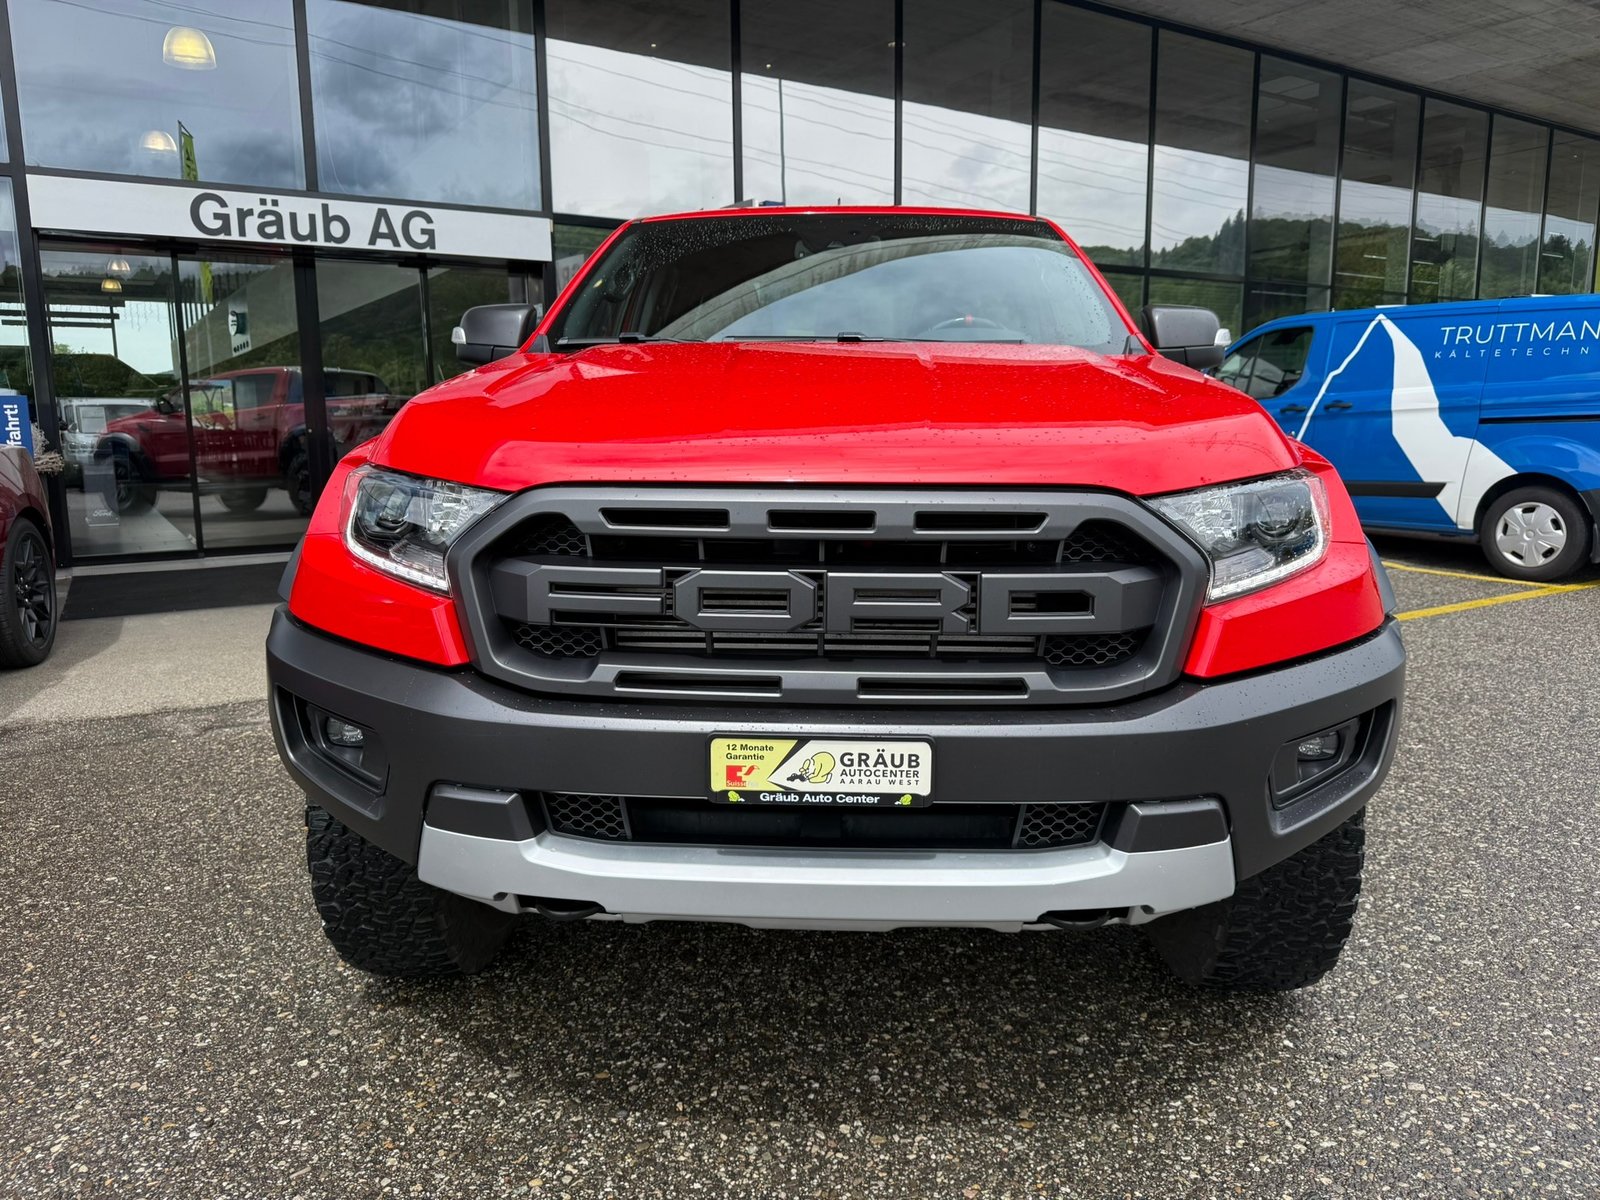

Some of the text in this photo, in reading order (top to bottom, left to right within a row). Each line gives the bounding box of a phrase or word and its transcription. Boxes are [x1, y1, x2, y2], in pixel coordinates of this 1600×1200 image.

[190, 192, 436, 250] Gräub AG
[1440, 320, 1600, 346] TRUTTMAN
[496, 562, 1164, 637] FORD
[726, 743, 774, 752] 12 Monate
[725, 752, 765, 761] Garantie
[839, 748, 920, 769] GRÄUB
[840, 768, 920, 778] AUTOCENTER
[759, 792, 880, 804] Gräub Auto Center
